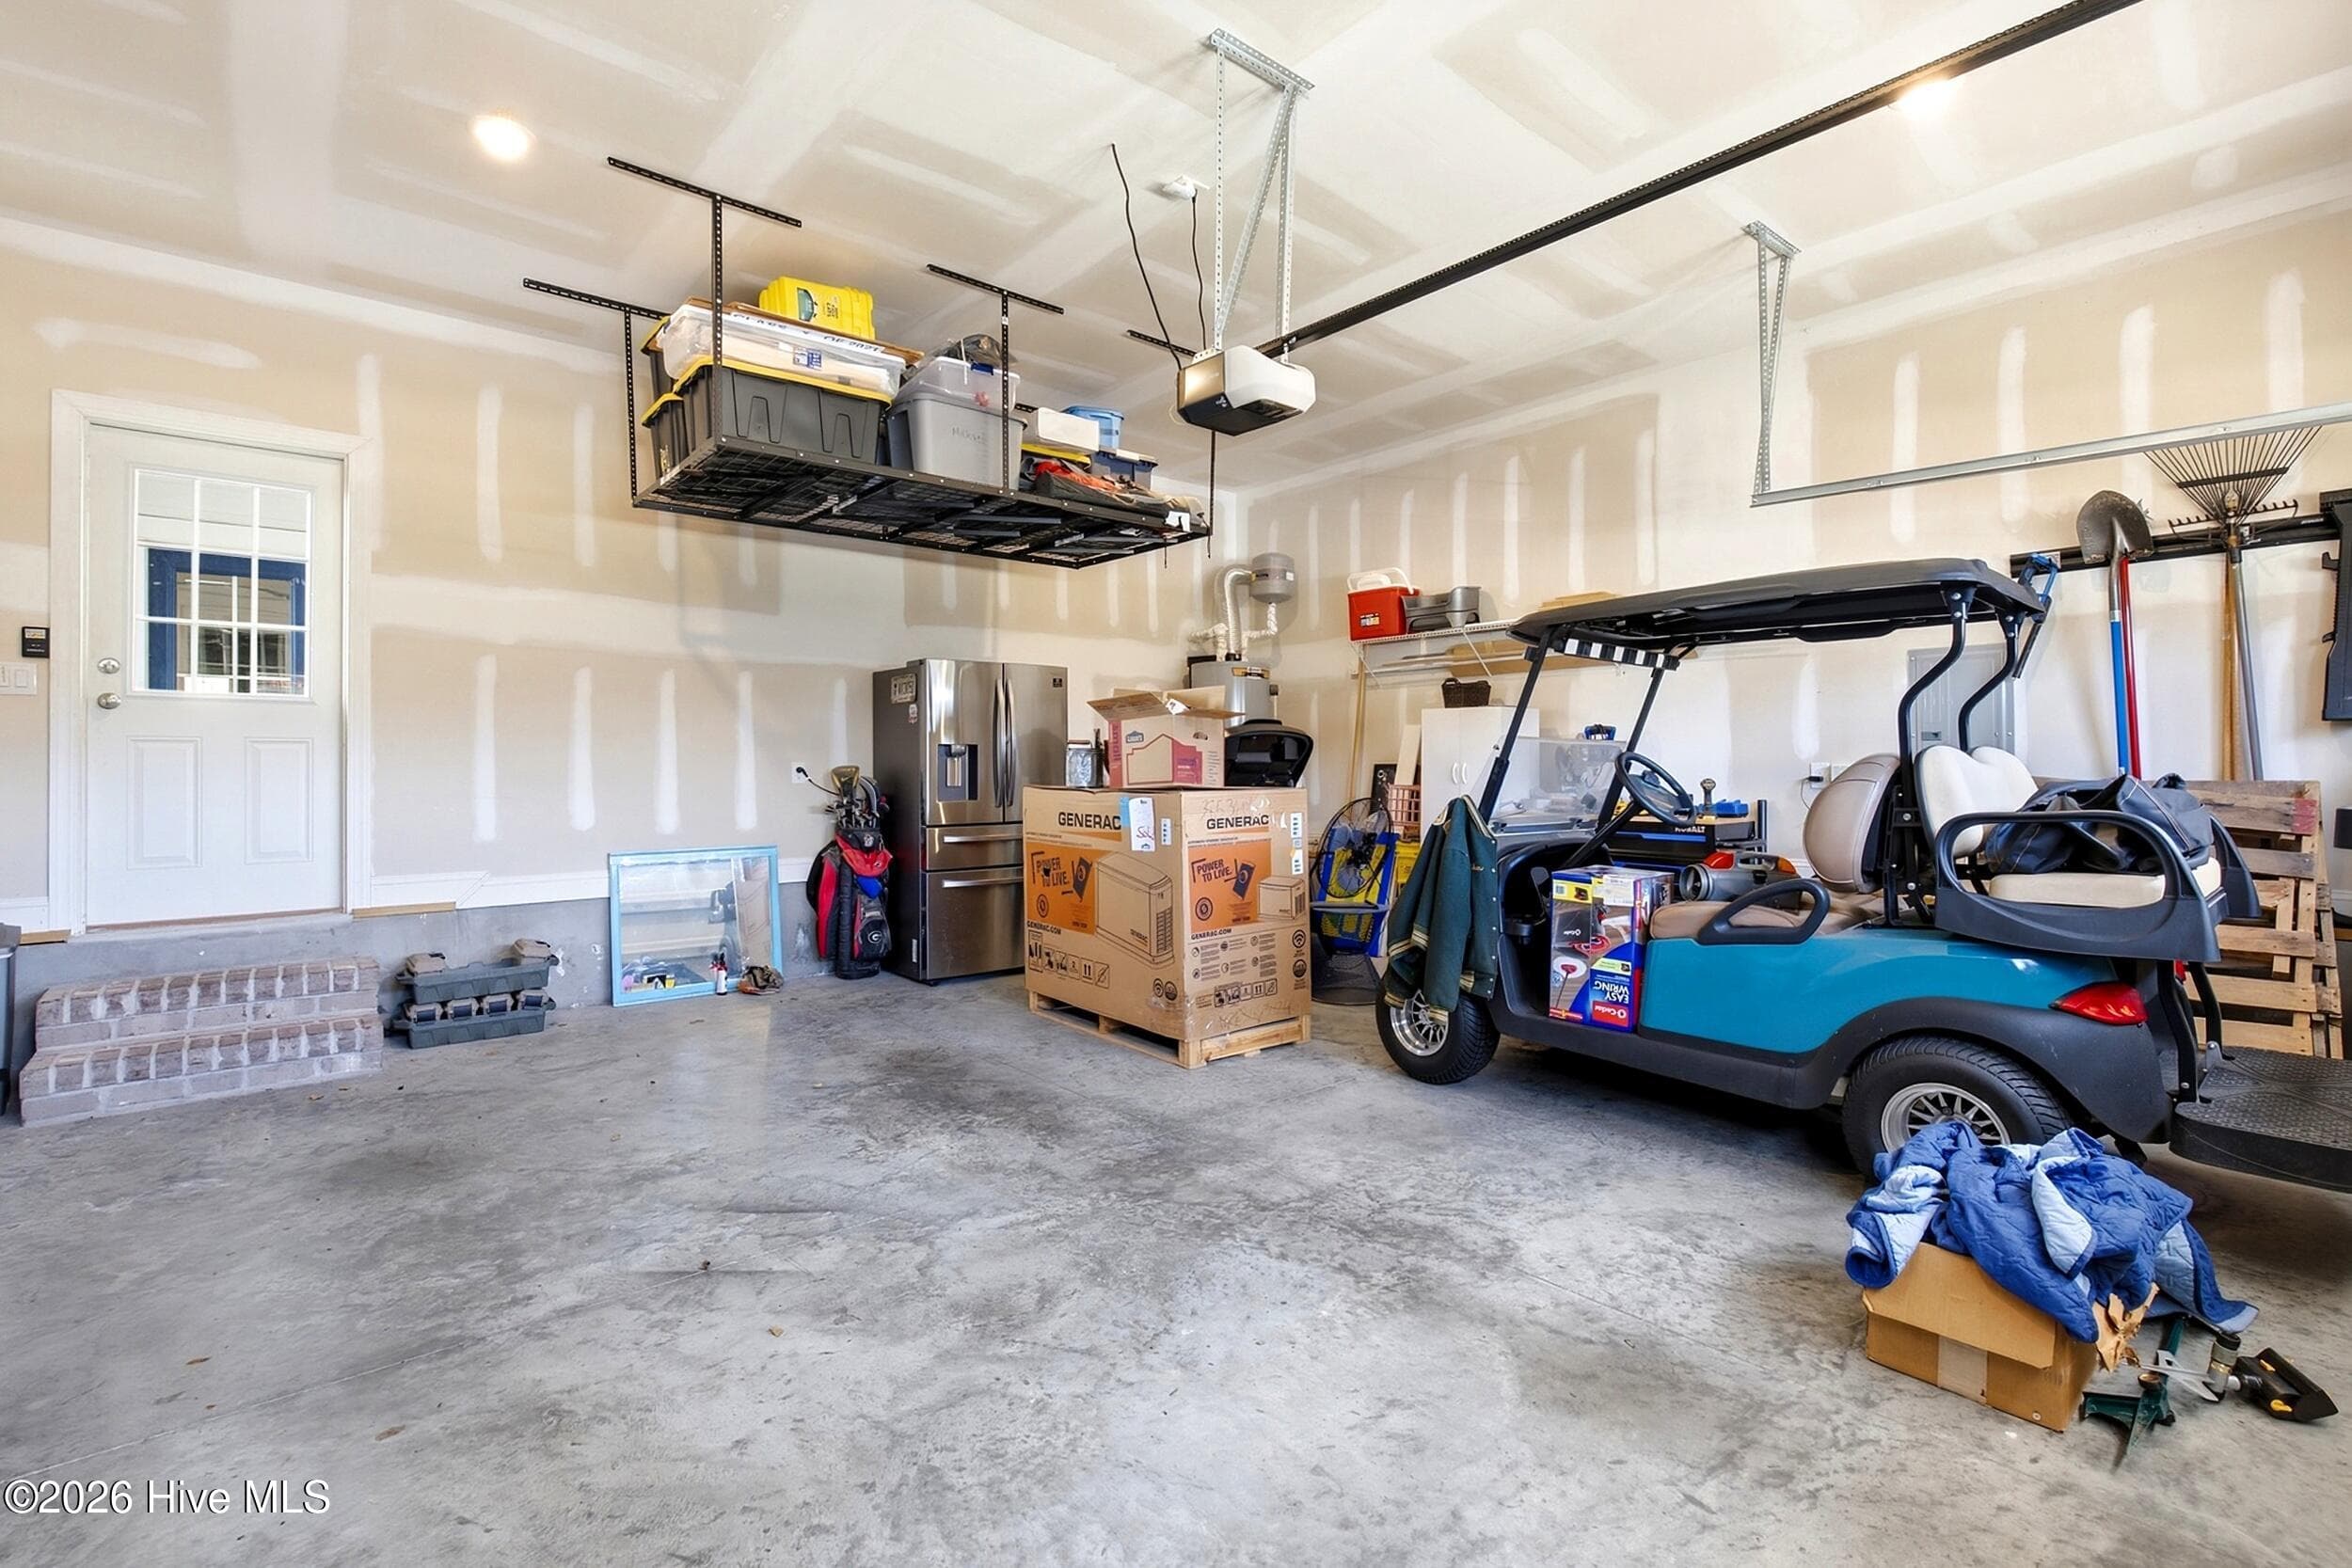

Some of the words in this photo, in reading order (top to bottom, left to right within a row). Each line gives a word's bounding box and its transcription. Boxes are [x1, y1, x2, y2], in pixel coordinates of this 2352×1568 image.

[1058, 811, 1121, 830] GENERAC
[1206, 815, 1269, 830] GENERAC
[1197, 859, 1224, 874] POWER
[1202, 873, 1213, 882] TO
[1594, 980, 1629, 995] WRING
[1604, 991, 1629, 1004] EASY
